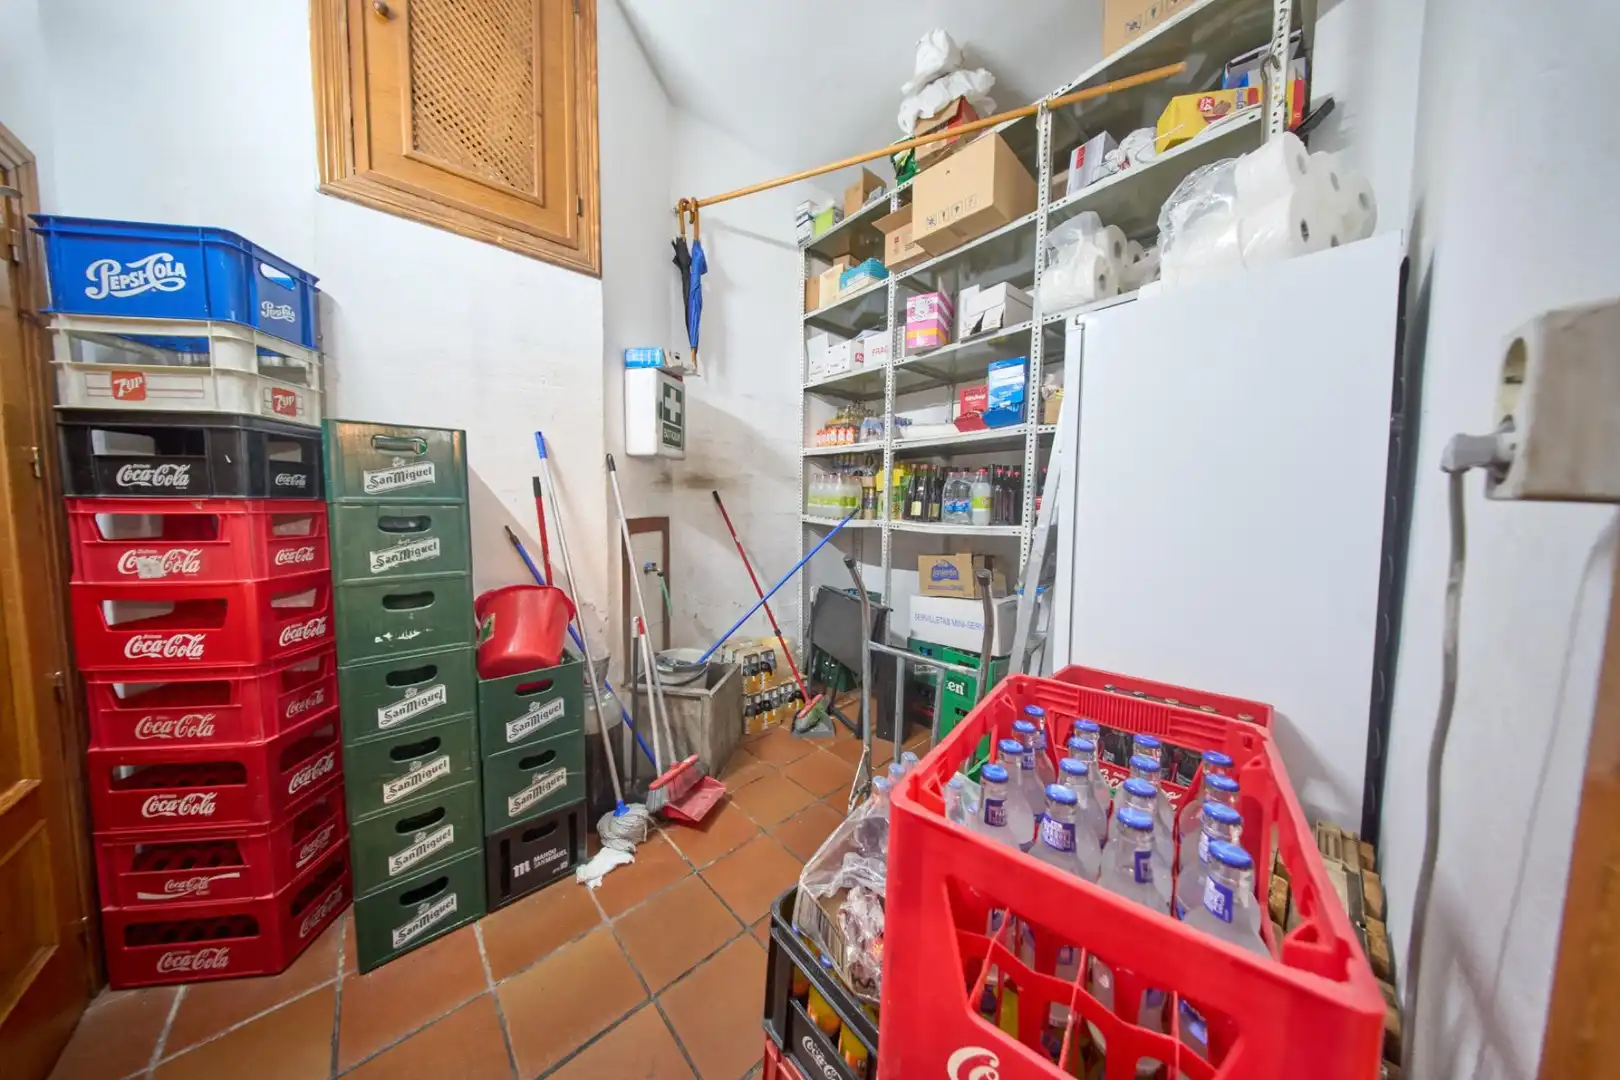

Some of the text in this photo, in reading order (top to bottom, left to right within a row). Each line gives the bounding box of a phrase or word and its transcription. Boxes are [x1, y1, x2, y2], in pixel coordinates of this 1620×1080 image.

[116, 464, 191, 487] Coca-Cola
[274, 546, 315, 566] Coca-Cola
[279, 616, 328, 647] Coca-Cola
[124, 633, 207, 659] Coca-Cola
[134, 712, 217, 740] Coca-Cola
[288, 751, 335, 795] Coca-Cola
[141, 791, 218, 818] Coca-Cola
[156, 947, 231, 973] Coca-Cola
